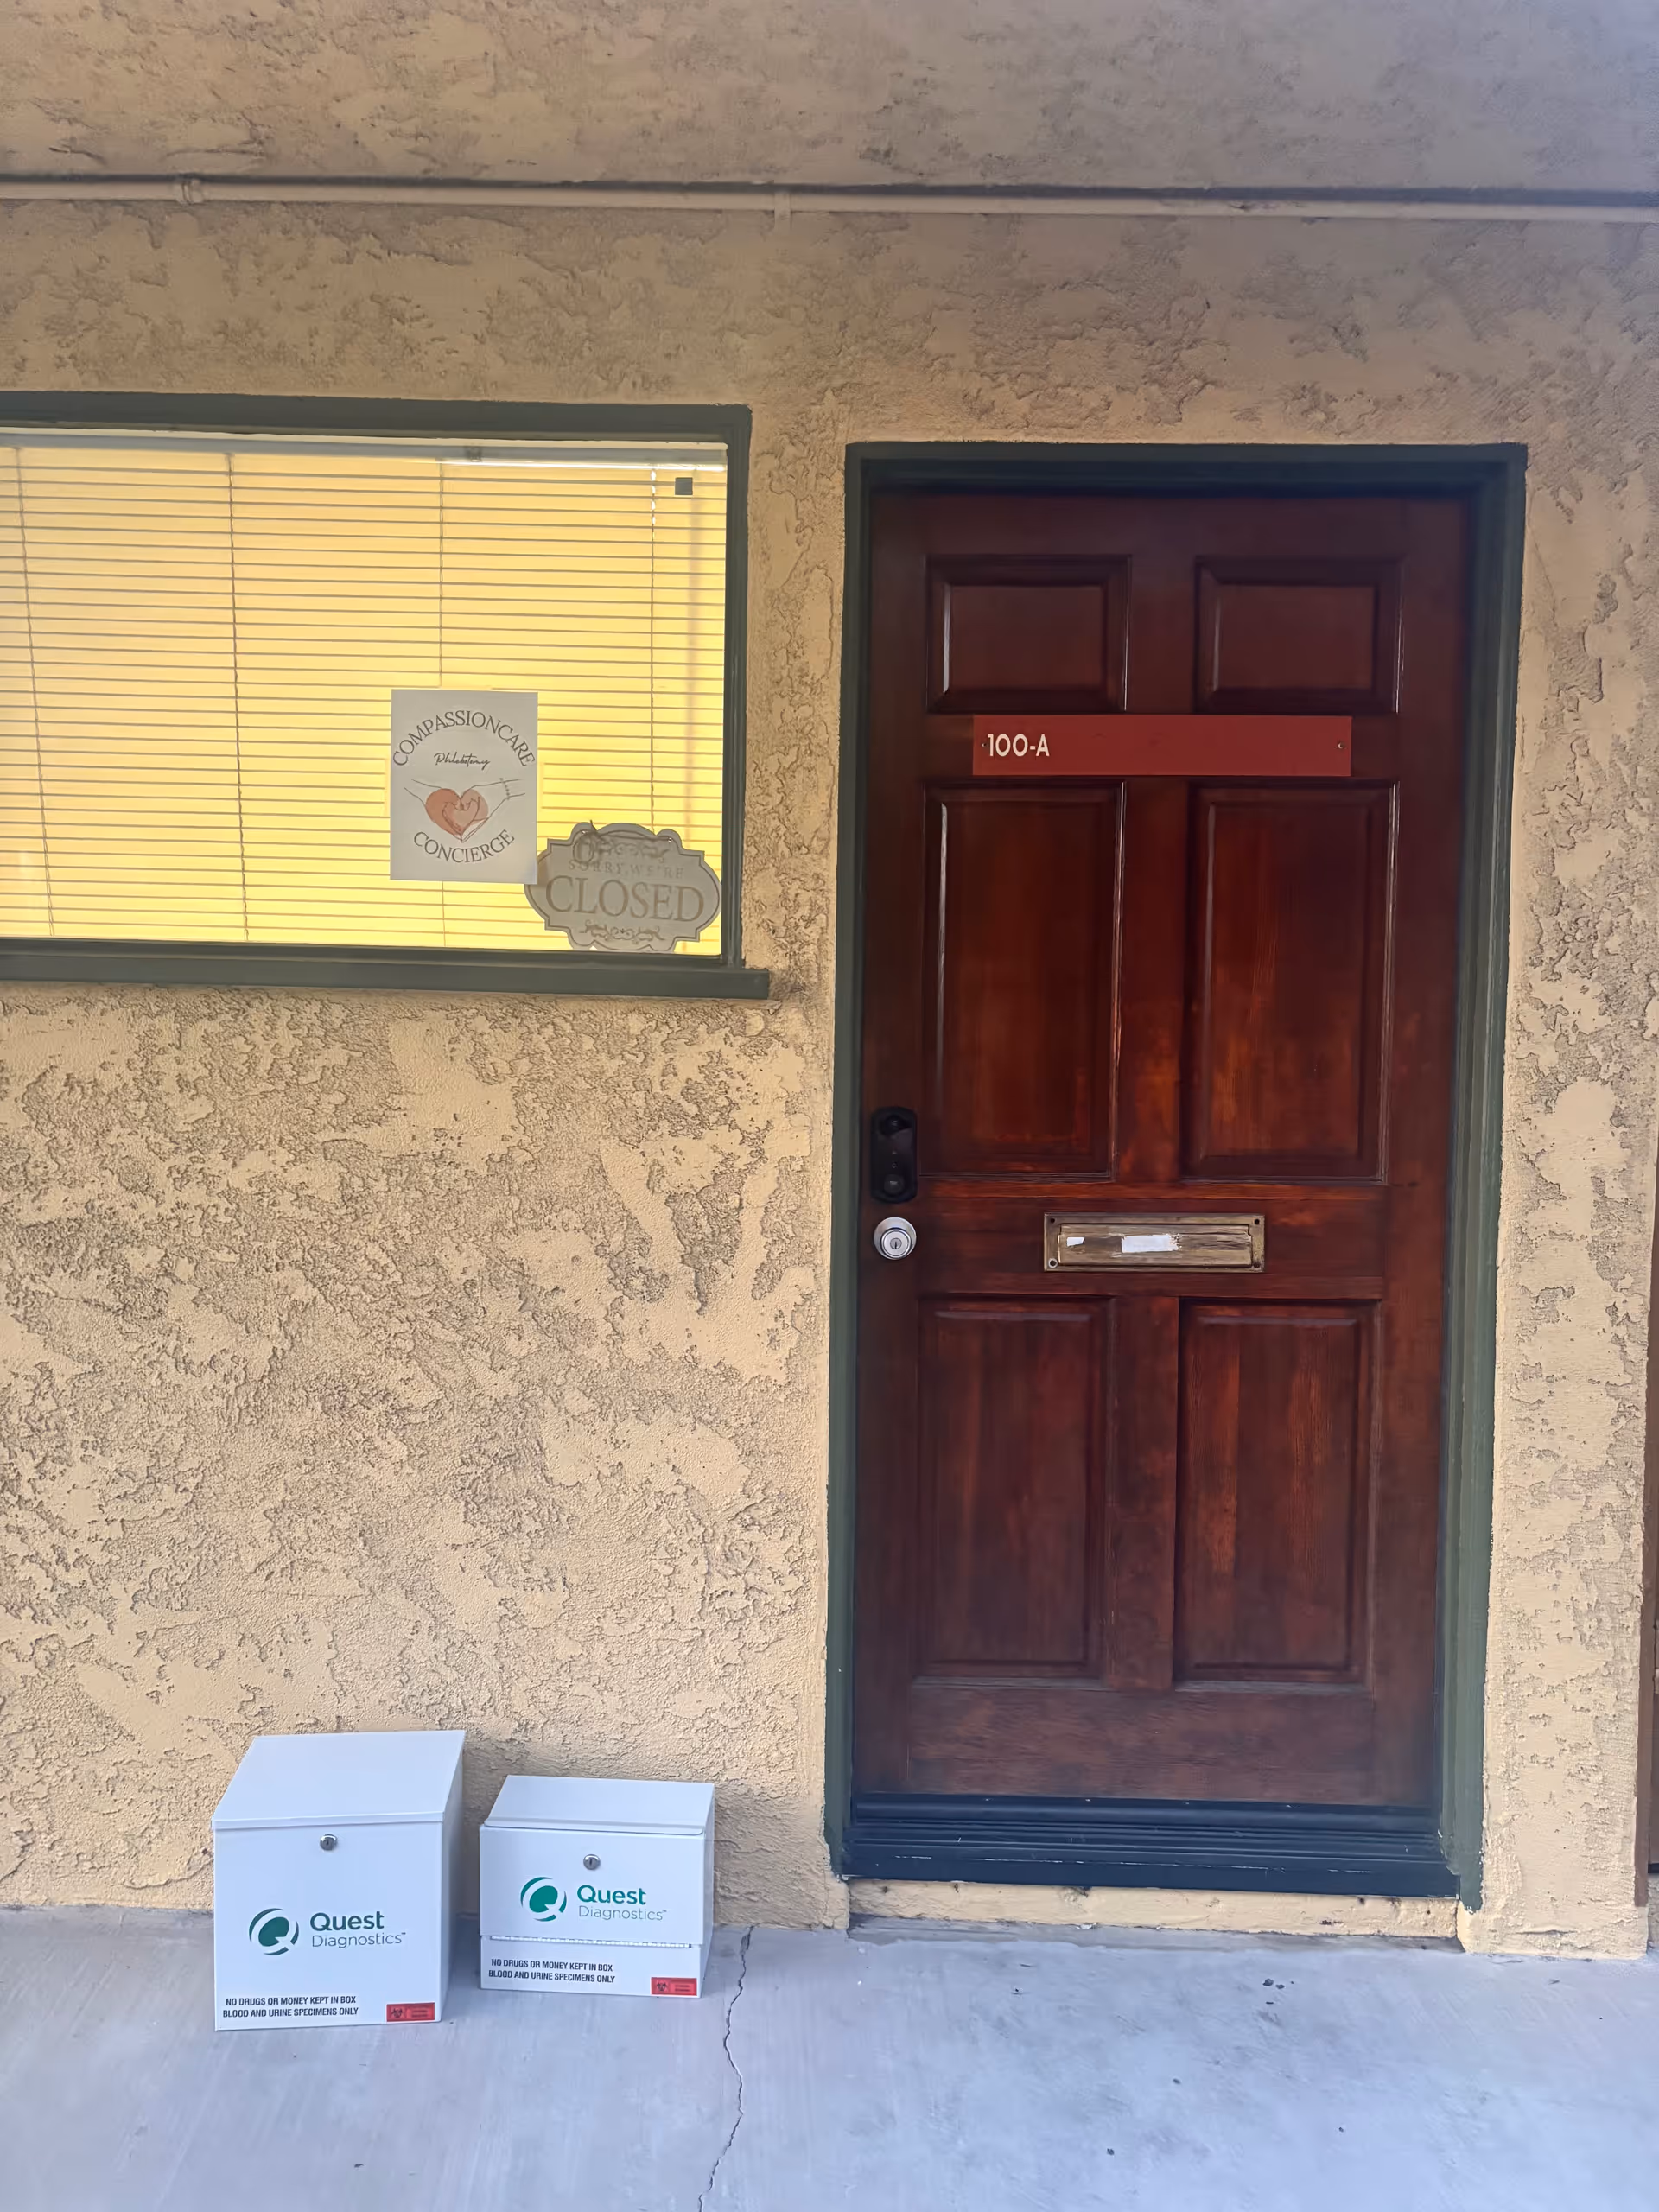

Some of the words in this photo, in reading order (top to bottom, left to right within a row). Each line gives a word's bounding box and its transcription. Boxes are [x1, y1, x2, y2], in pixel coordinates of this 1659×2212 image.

[392, 709, 536, 767] COMPASSIONCARE
[988, 734, 1051, 757] 100-A
[413, 829, 516, 864] CONCIERGE
[545, 874, 704, 923] CLOSED
[576, 1885, 647, 1905] Quest
[309, 1910, 385, 1931] Quest
[491, 1958, 502, 1967] NO
[503, 1959, 529, 1967] DRUGS
[530, 1960, 541, 1968] OR
[542, 1961, 569, 1970] MONEY
[569, 1962, 588, 1971] KEPT
[488, 1969, 513, 1979] BLOOD
[514, 1970, 530, 1980] AND
[531, 1972, 553, 1980] URINE
[554, 1973, 595, 1982] SPECIMENS
[596, 1974, 616, 1983] ONLY
[226, 1998, 238, 2006] NO
[238, 1997, 266, 2005] DRUGS
[267, 1997, 279, 2005] OR
[280, 1996, 308, 2005] MONEY
[309, 1996, 329, 2005] KEPT
[340, 1995, 357, 2004] BOX
[222, 2009, 249, 2018] BLOOD
[250, 2009, 267, 2018] AND
[268, 2008, 292, 2017] URINE
[293, 2007, 337, 2017] SPECIMENS
